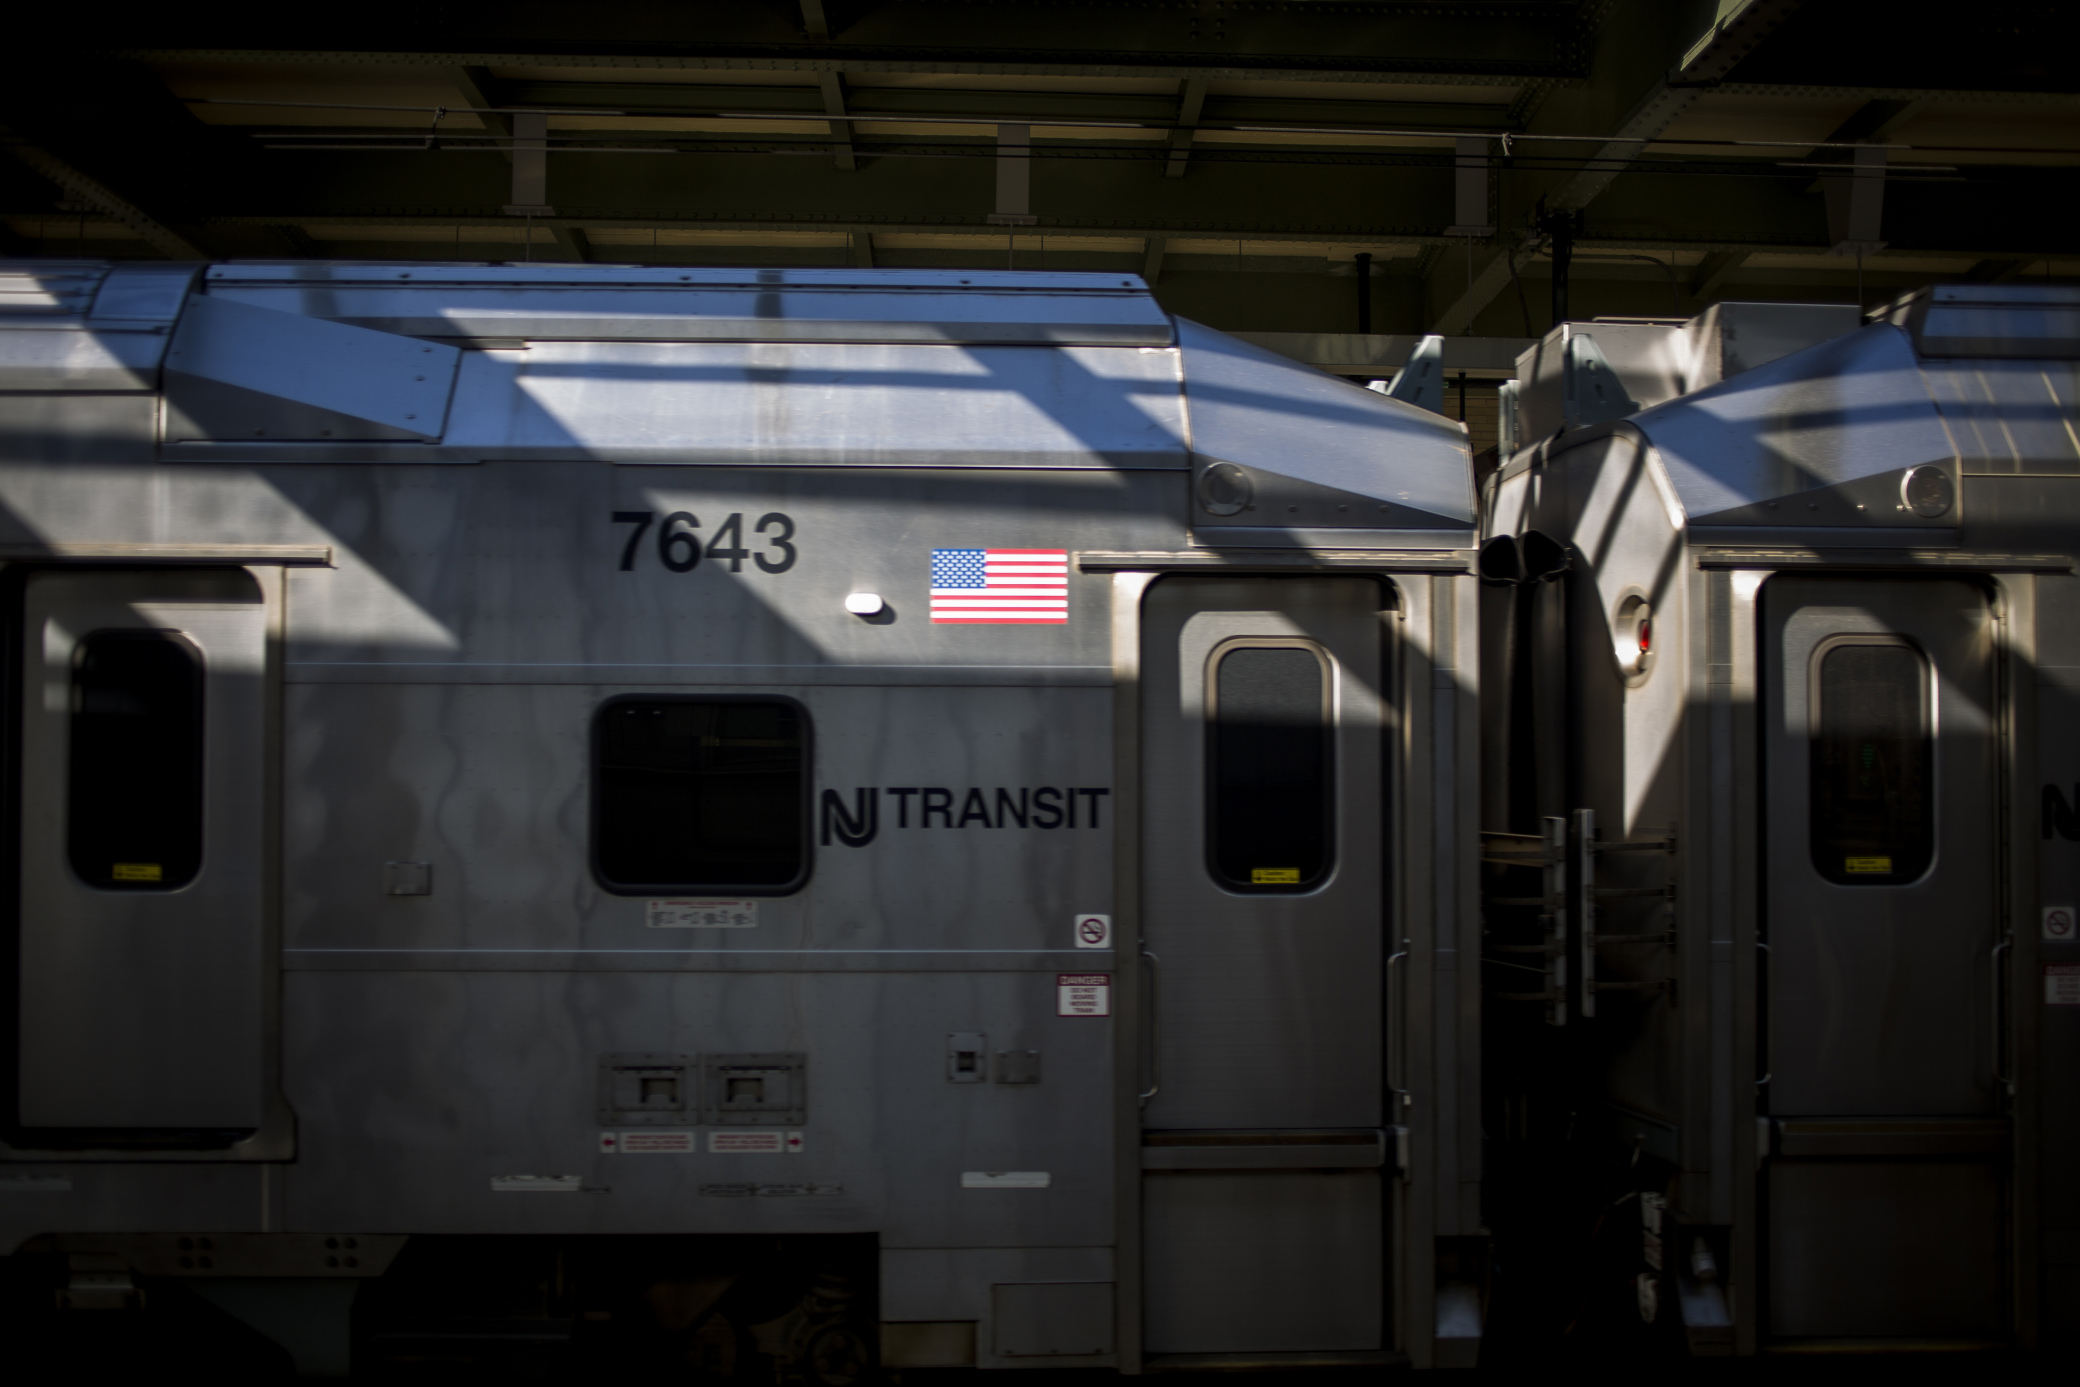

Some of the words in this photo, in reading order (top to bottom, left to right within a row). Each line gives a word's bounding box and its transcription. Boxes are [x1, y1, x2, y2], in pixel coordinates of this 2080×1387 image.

[611, 511, 798, 574] 7643
[821, 788, 879, 847] NJ
[885, 787, 1110, 829] TRANSIT
[1060, 976, 1107, 985] DANGER
